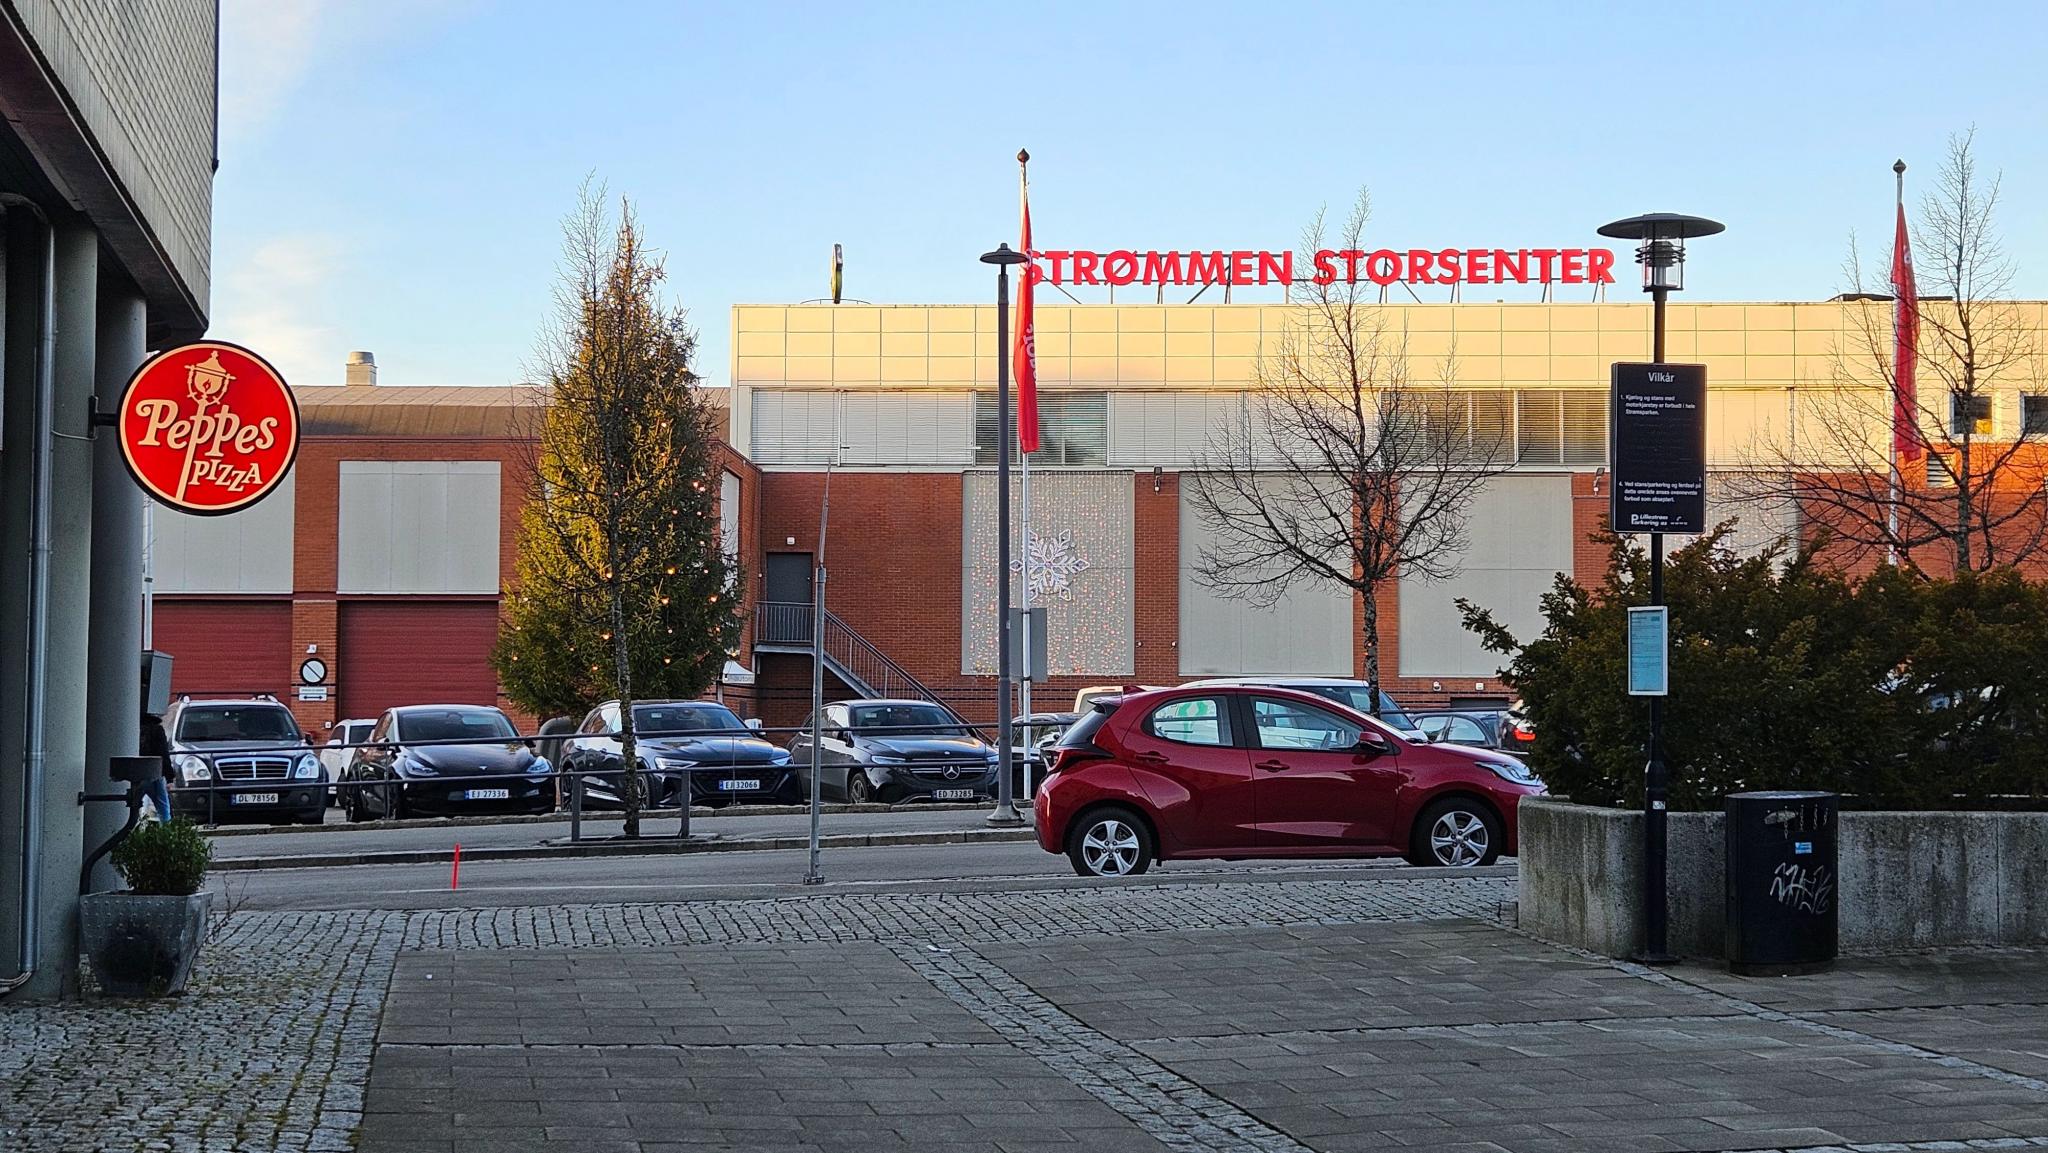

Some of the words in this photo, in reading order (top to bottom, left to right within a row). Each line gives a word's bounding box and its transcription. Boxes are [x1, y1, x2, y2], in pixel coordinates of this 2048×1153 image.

[1313, 248, 1616, 286] STORSENTER
[1648, 372, 1675, 383] Vilkår
[135, 398, 278, 458] Peppes
[188, 459, 263, 492] PIZZA
[736, 781, 758, 789] 32066
[252, 793, 276, 802] 78156
